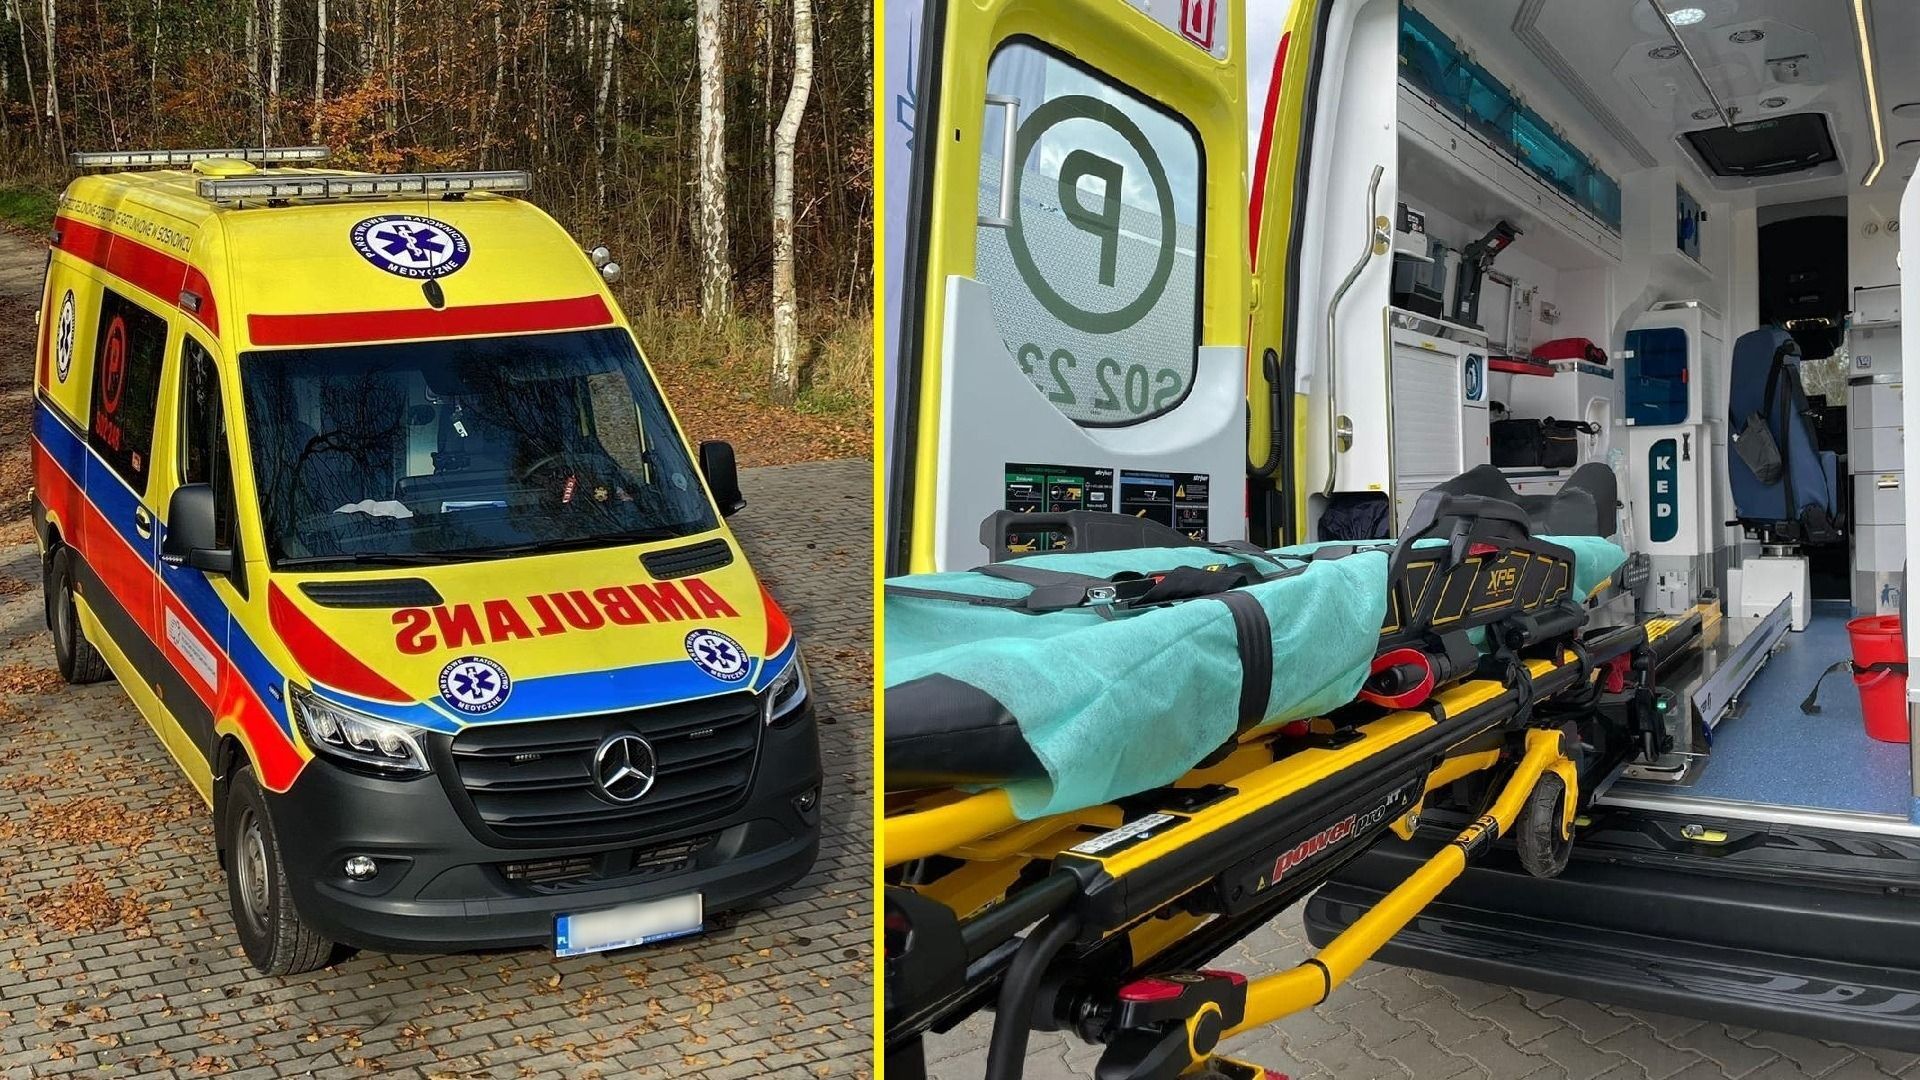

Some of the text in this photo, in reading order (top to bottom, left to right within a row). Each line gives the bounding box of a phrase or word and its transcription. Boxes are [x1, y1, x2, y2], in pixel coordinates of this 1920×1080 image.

[157, 226, 193, 252] SOSNOWCU
[403, 216, 467, 253] RATOWNICTWO
[387, 260, 459, 277] MEDYCZNE
[1656, 456, 1672, 517] KED
[1487, 567, 1516, 591] XPS
[457, 695, 502, 711] MEDYCZNE
